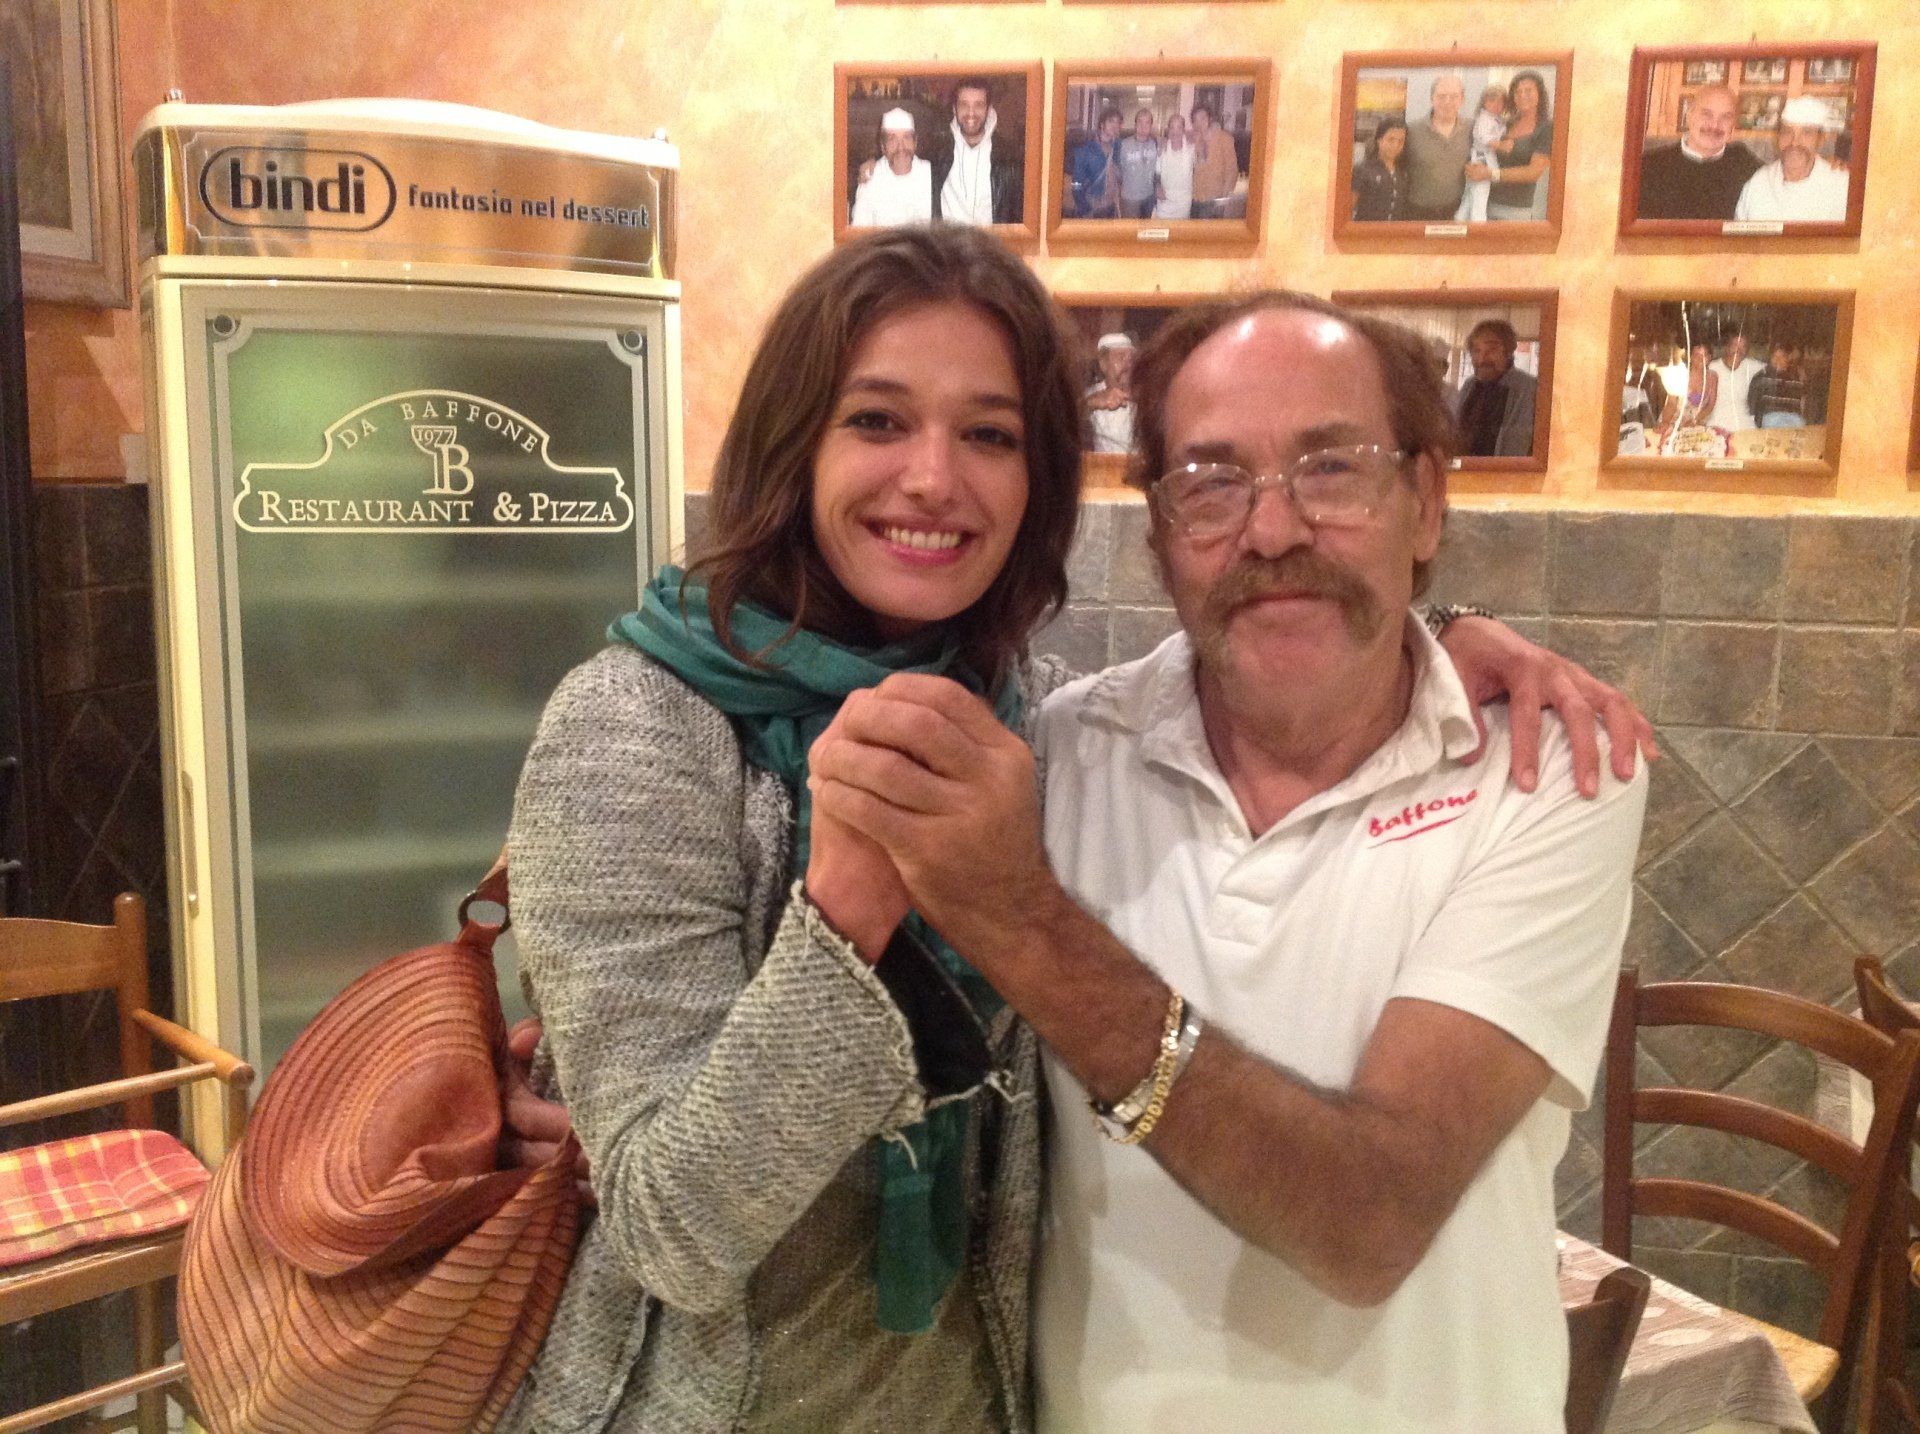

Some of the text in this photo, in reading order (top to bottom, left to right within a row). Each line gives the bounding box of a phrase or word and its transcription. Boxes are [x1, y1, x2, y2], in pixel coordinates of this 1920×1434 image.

[229, 156, 649, 227] bindi fantasia nel dessert
[338, 400, 538, 453] DA BAFFONE
[493, 492, 522, 523] &
